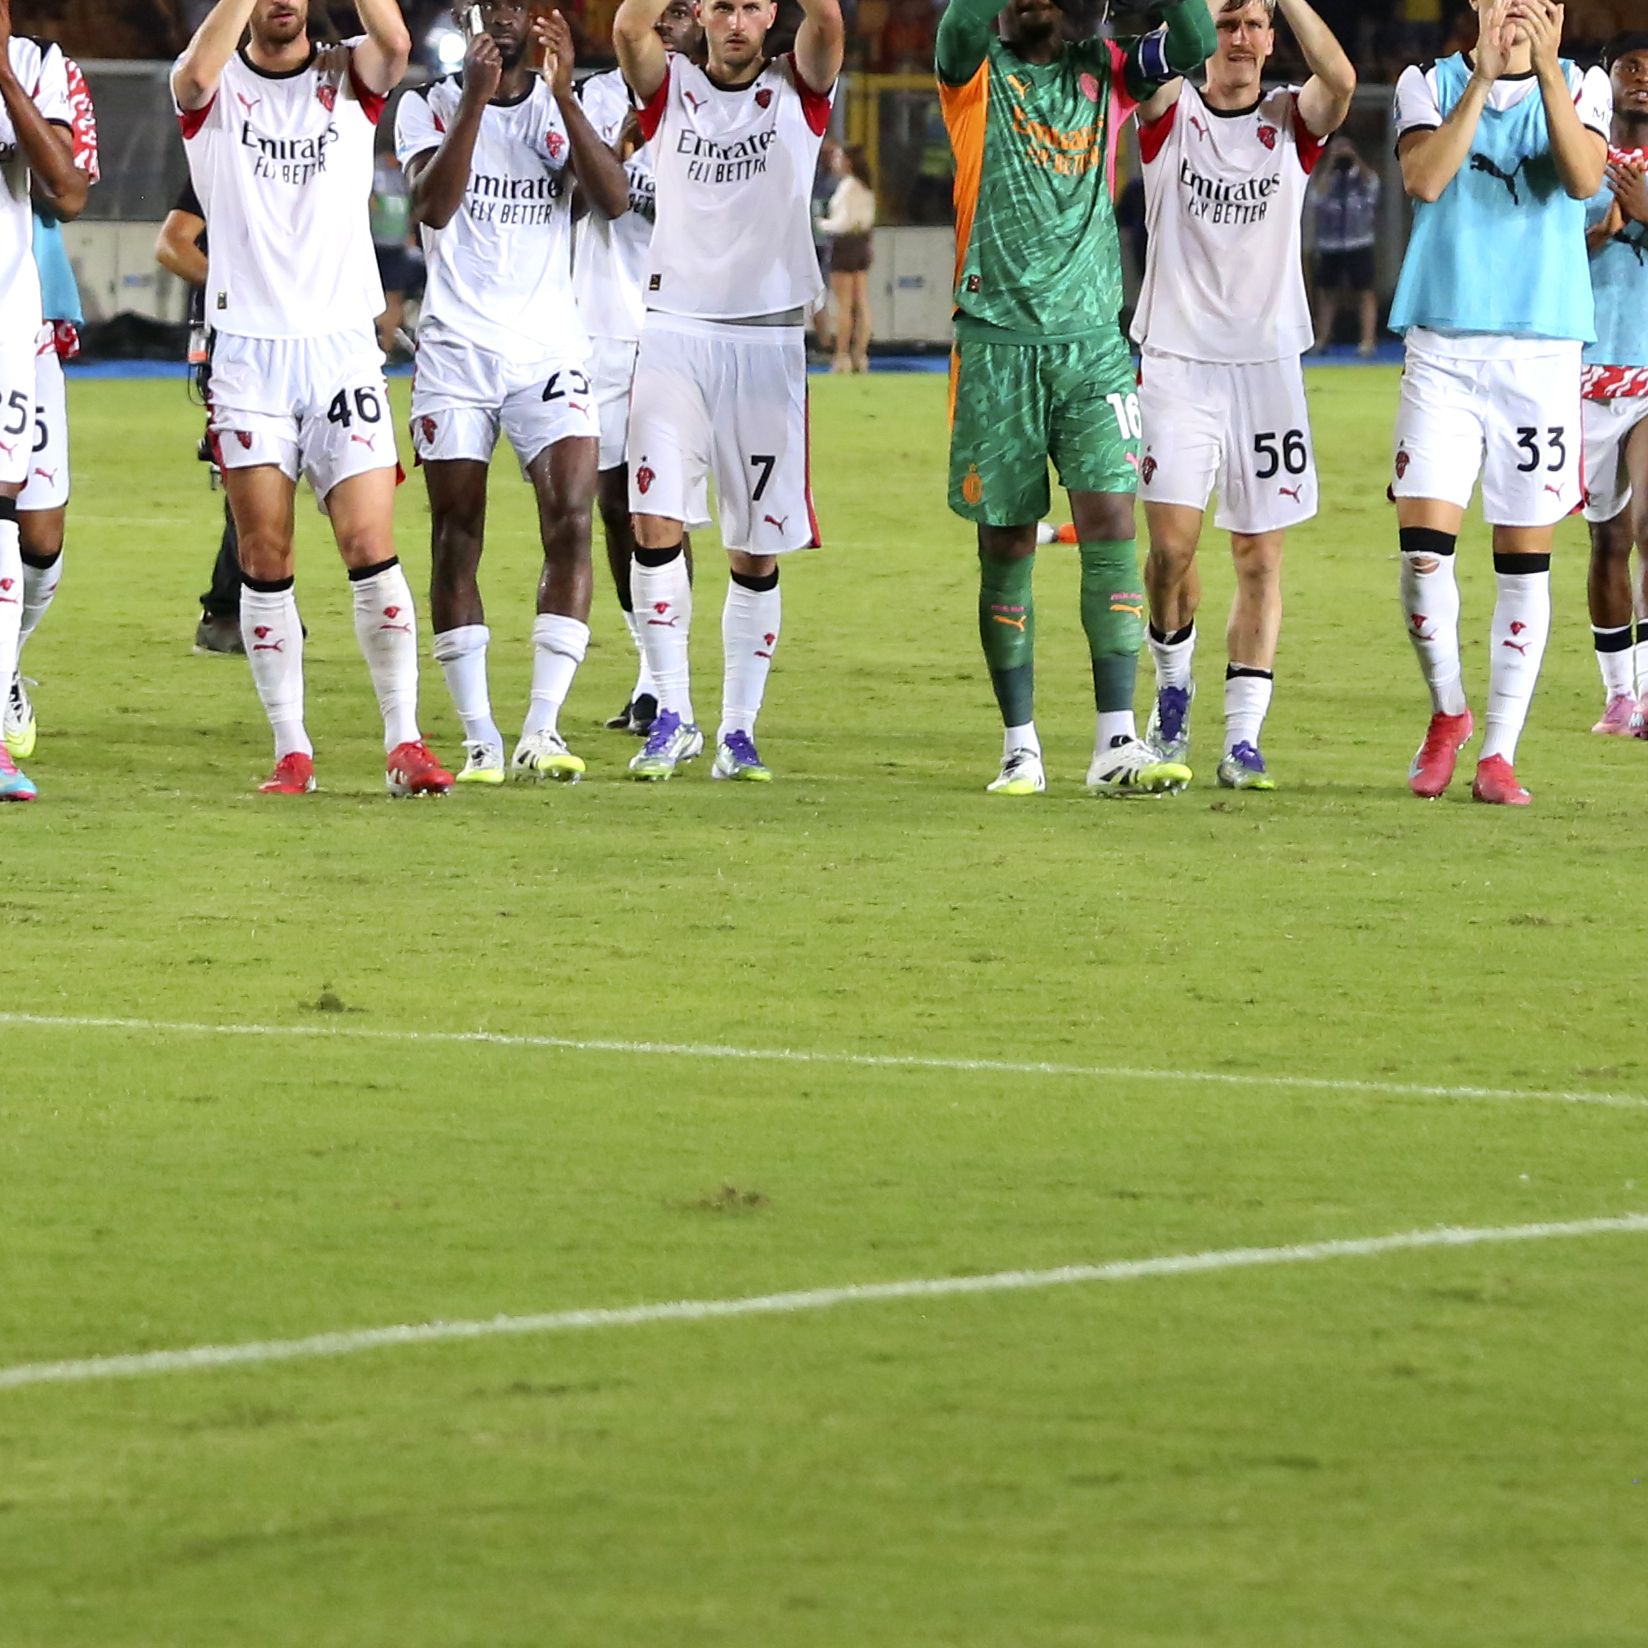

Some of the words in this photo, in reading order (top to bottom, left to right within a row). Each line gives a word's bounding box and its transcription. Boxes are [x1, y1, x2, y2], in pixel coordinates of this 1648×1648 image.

[468, 173, 562, 200] mirate
[1180, 158, 1280, 201] Emirates
[470, 200, 495, 223] FLY
[500, 204, 553, 225] BETTER
[1213, 201, 1268, 225] BETTER
[326, 386, 381, 428] 46
[1107, 392, 1142, 439] 16
[1254, 429, 1307, 479] 56
[1516, 426, 1566, 473] 33
[750, 455, 776, 501] 7
